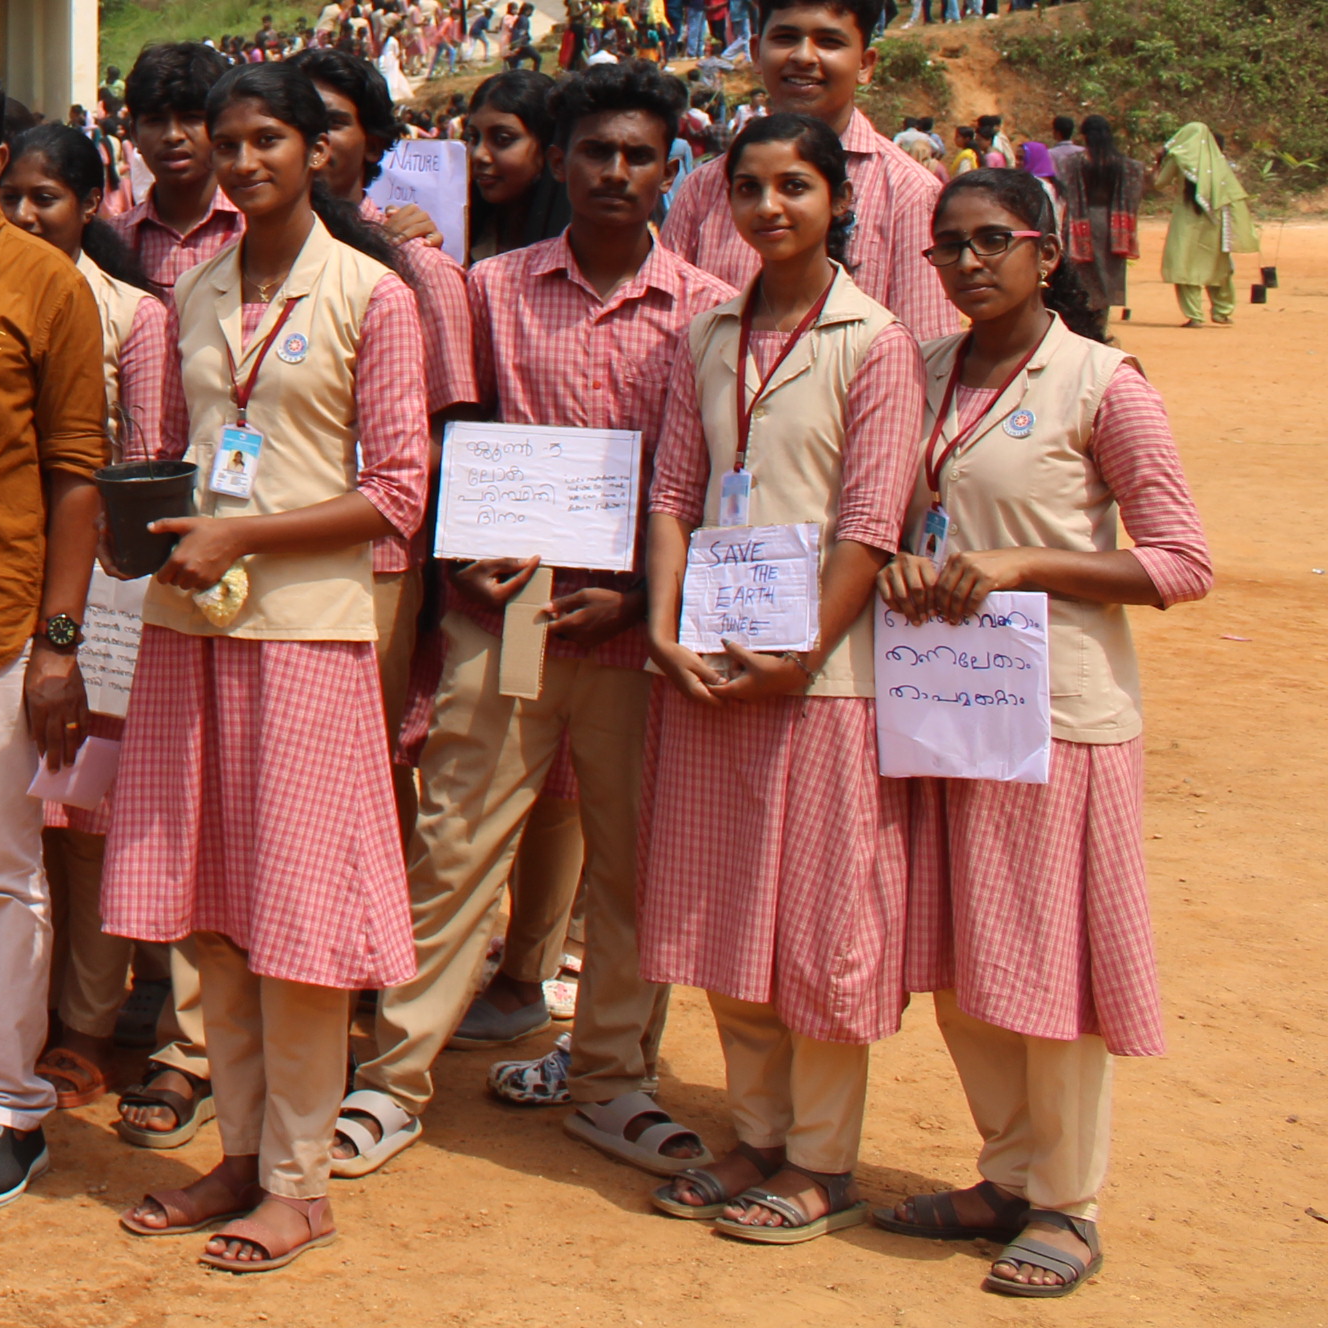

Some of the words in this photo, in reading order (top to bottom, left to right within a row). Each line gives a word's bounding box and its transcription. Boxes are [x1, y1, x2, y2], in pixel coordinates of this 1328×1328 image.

[477, 504, 526, 524] ദിനം
[707, 539, 769, 567] SAVE
[749, 564, 779, 583] THE
[715, 585, 775, 609] EARTH
